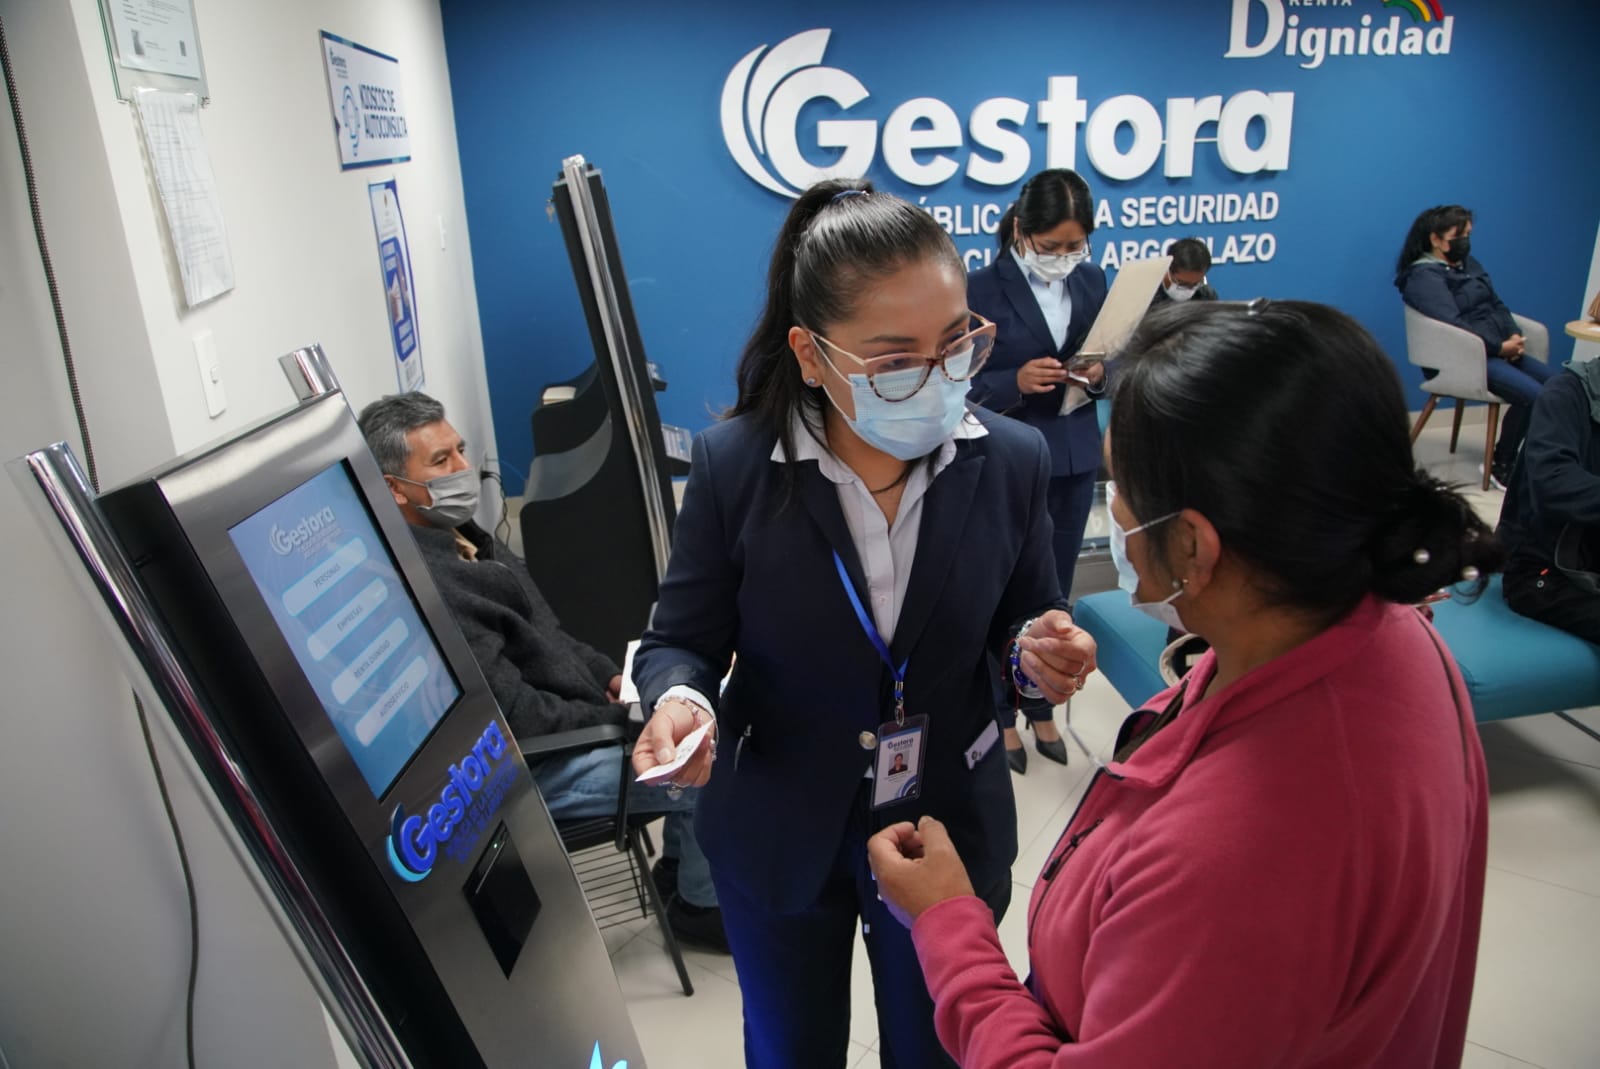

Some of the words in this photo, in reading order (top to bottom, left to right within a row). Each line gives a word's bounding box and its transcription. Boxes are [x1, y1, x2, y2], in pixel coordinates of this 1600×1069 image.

[1224, 0, 1454, 69] Dignidad
[359, 83, 388, 111] KIOSCOS
[364, 113, 408, 139] AUTOCONSULTA
[762, 66, 1295, 193] Gestora
[1121, 191, 1279, 228] SEGURIDAD
[1196, 233, 1276, 264] LAZO
[275, 504, 336, 556] Gestora
[400, 719, 507, 872] Gestora
